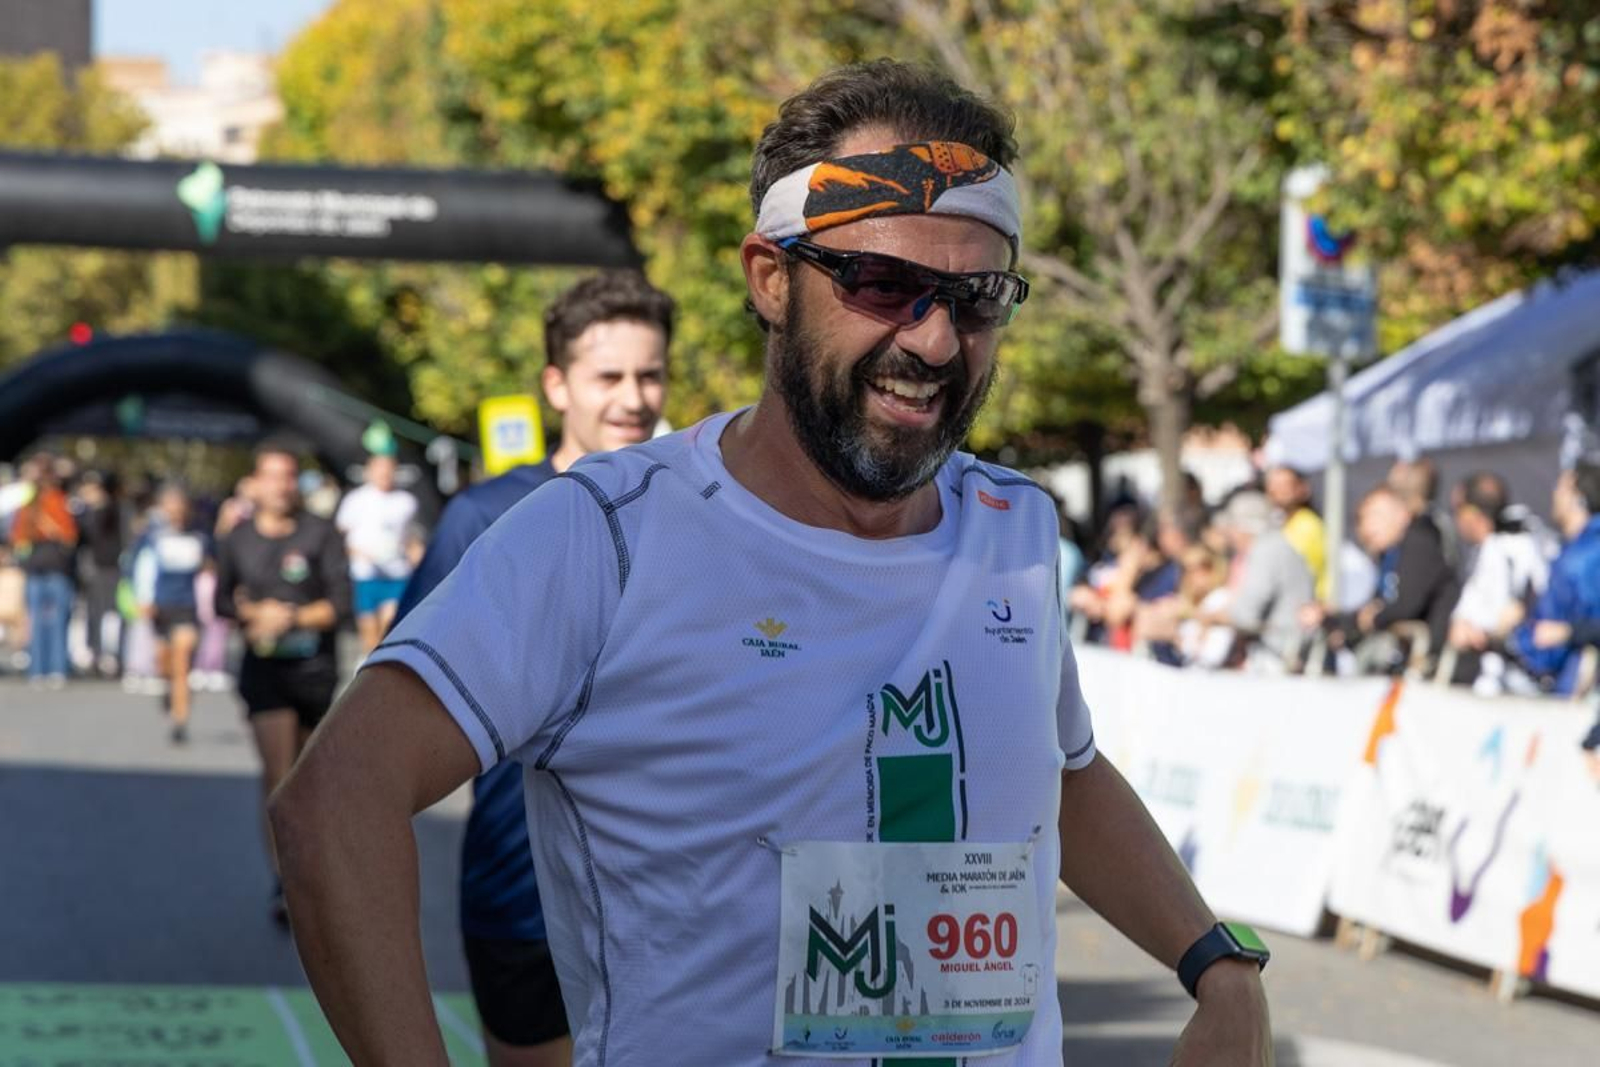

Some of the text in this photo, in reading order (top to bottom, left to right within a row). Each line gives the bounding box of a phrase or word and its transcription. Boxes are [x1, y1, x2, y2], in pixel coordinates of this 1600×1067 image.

[742, 638, 765, 647] CAJA
[761, 648, 785, 658] JAÉN
[864, 756, 873, 767] DE
[964, 853, 993, 865] XXVIII
[927, 868, 1025, 882] MEDIA MARATÓN DE JAÉN
[940, 884, 949, 894] &
[927, 912, 1018, 960] 960
[940, 960, 1014, 973] MIGUEL ÁNGEL
[952, 999, 961, 1008] DE
[964, 998, 1002, 1008] NOVIEMBRE
[1004, 998, 1012, 1007] DE
[931, 1031, 982, 1042] calderón
